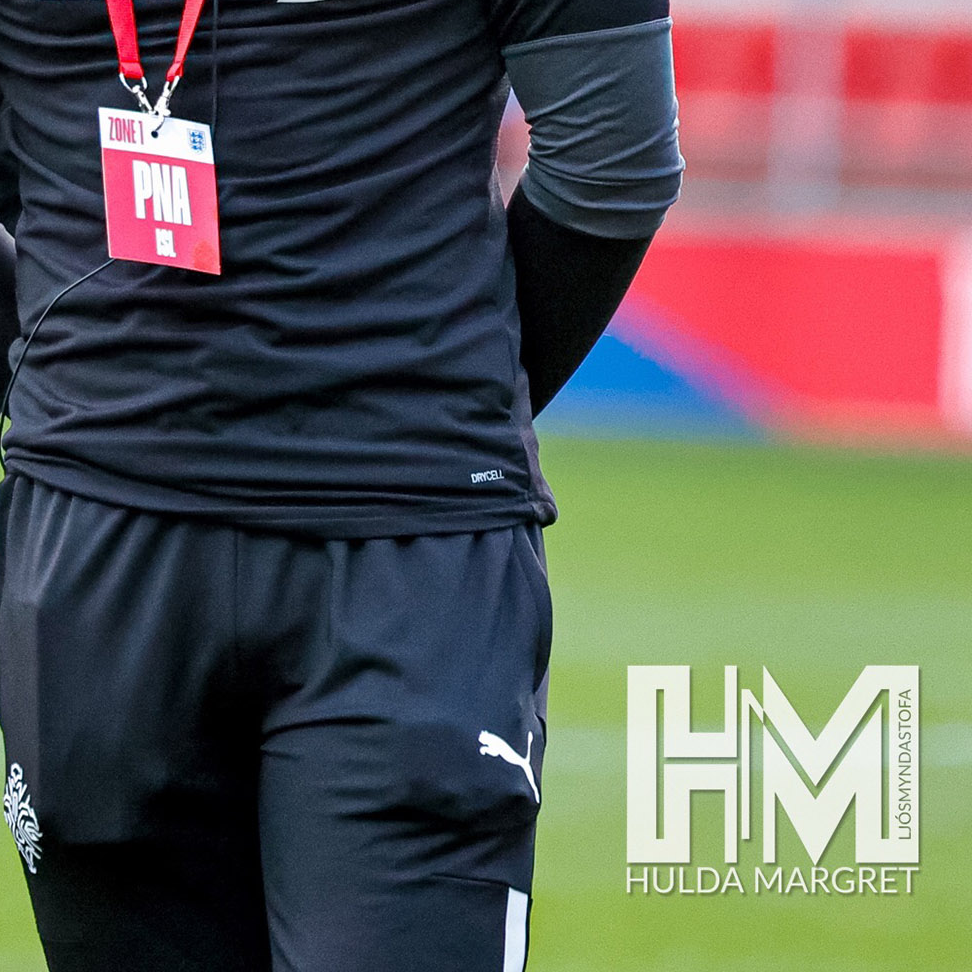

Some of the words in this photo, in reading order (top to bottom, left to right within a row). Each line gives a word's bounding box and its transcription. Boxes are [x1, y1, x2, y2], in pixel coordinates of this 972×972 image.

[108, 116, 137, 144] ZONE
[138, 120, 144, 145] 1
[132, 159, 193, 226] PNA
[470, 469, 505, 484] DRYCELL
